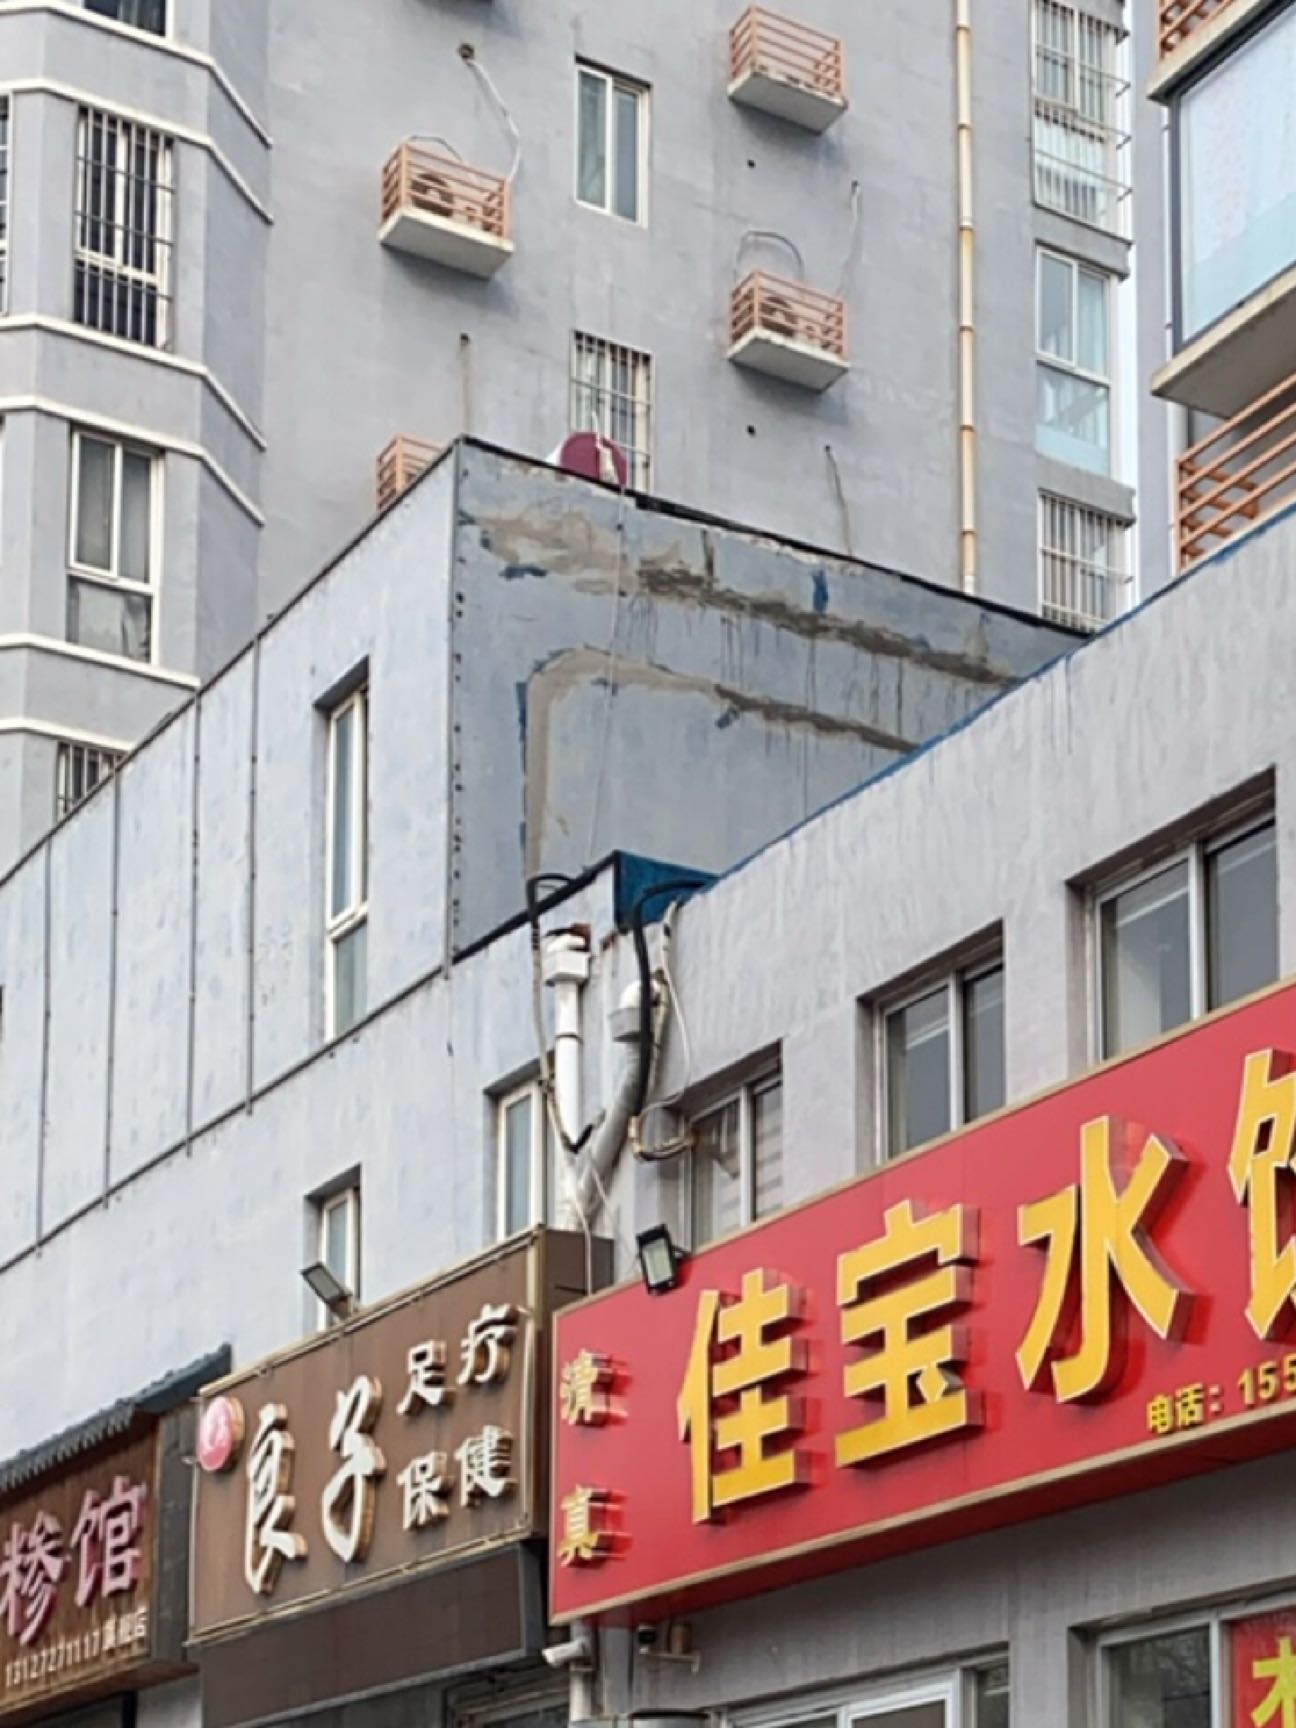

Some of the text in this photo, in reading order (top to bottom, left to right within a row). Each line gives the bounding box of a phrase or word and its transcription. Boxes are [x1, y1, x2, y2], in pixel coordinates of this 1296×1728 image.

[397, 1303, 520, 1415] 足疗
[244, 1375, 387, 1595] 良子
[397, 1424, 518, 1531] 保健
[559, 1347, 610, 1569] 清真
